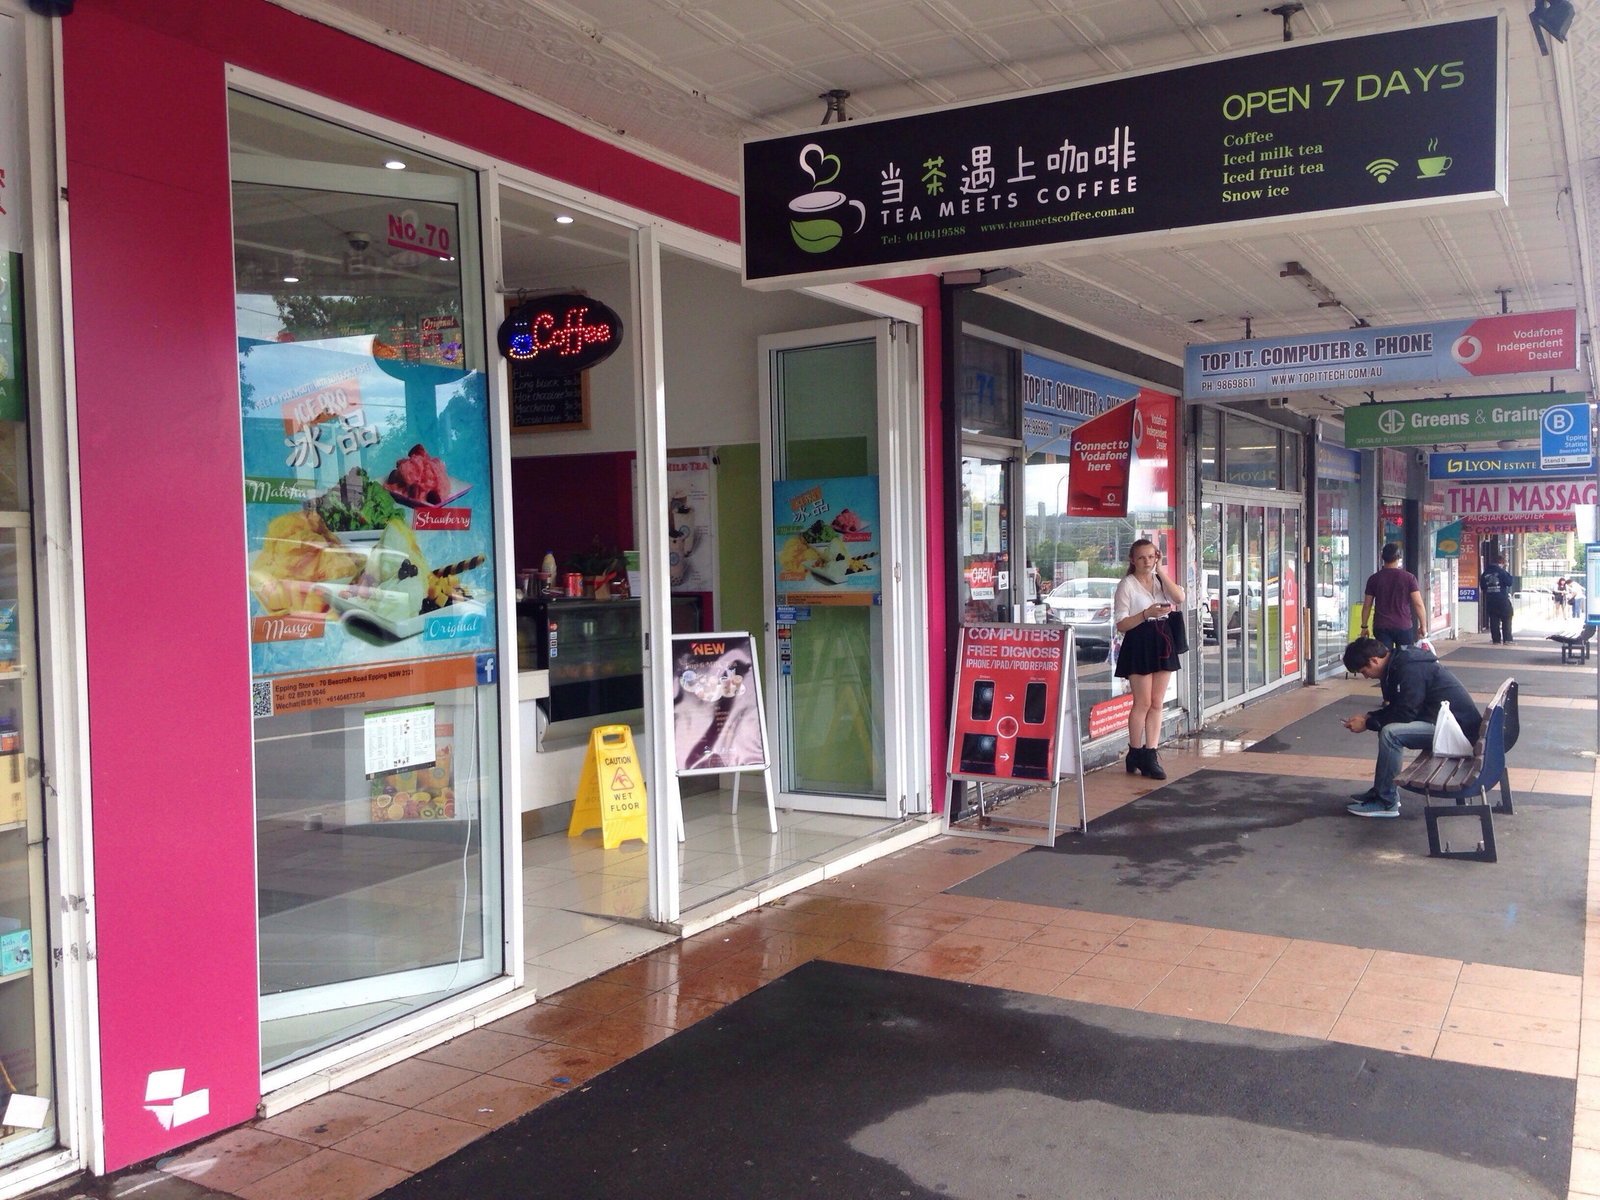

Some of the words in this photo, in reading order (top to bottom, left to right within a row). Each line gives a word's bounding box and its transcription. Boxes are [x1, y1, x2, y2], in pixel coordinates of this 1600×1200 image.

[1222, 84, 1310, 121] OPEN
[1322, 78, 1345, 106] 7
[1356, 60, 1465, 102] DAYS
[1223, 130, 1274, 148] Coffee
[1223, 151, 1255, 167] Iced
[1260, 146, 1294, 163] milk
[1298, 143, 1324, 157] tea
[881, 125, 1137, 205] 当茶遇上咖啡
[1222, 170, 1255, 185] Iced
[1260, 164, 1295, 182] fruit
[1299, 162, 1325, 176] tea
[881, 207, 922, 226] TEA
[939, 192, 1018, 217] MEETS
[1037, 176, 1138, 205] COFFEE
[1222, 189, 1264, 203] Snow
[1267, 185, 1290, 198] ice
[388, 213, 450, 251] No.70
[881, 234, 901, 246] Tel:
[906, 226, 966, 242] 0410419588
[980, 205, 1135, 233] www.teameetscoffee.com.au
[533, 306, 611, 356] Coffee
[1513, 327, 1564, 338] Vodafone
[1200, 354, 1232, 372] TOP
[1234, 352, 1257, 368] I.T.
[1260, 343, 1350, 366] COMPUTER
[1354, 343, 1368, 357] &
[1375, 333, 1433, 354] PHONE
[1496, 339, 1564, 352] Independent
[1528, 349, 1563, 361] Dealer
[1217, 376, 1257, 391] 98698611
[1024, 374, 1041, 404] TOP
[1056, 382, 1098, 417] COMPUTER
[1411, 411, 1470, 428] Greens
[1475, 408, 1487, 425] &
[1553, 414, 1566, 429] B
[285, 409, 380, 468] 冰品
[1074, 441, 1116, 451] Connect
[1118, 440, 1129, 449] to
[1565, 434, 1588, 442] Epping
[1080, 451, 1128, 461] Vodafone
[690, 462, 709, 470] TEA
[1087, 462, 1112, 472] here
[1465, 460, 1501, 472] LYON
[1504, 462, 1537, 470] ESTATE
[248, 480, 309, 502] Matcha
[1448, 488, 1500, 513] THAI
[416, 511, 470, 527] Strawberry
[1475, 525, 1541, 534] COMPUTER
[973, 567, 993, 583] OPEN
[430, 616, 479, 638] Original
[968, 628, 1060, 642] COMPUTERS
[693, 642, 725, 655] NEW
[967, 645, 998, 657] FREE
[1001, 646, 1060, 659] DIGNOSIS
[966, 659, 1030, 670] IPHONE/IPAD/IPOD
[1030, 661, 1058, 671] REPAIRS
[275, 683, 297, 692] Epping
[353, 674, 368, 683] Road
[368, 673, 388, 682] Epping
[388, 670, 402, 678] NSW
[605, 756, 631, 765] CAUTION
[610, 803, 640, 812] FLOOR
